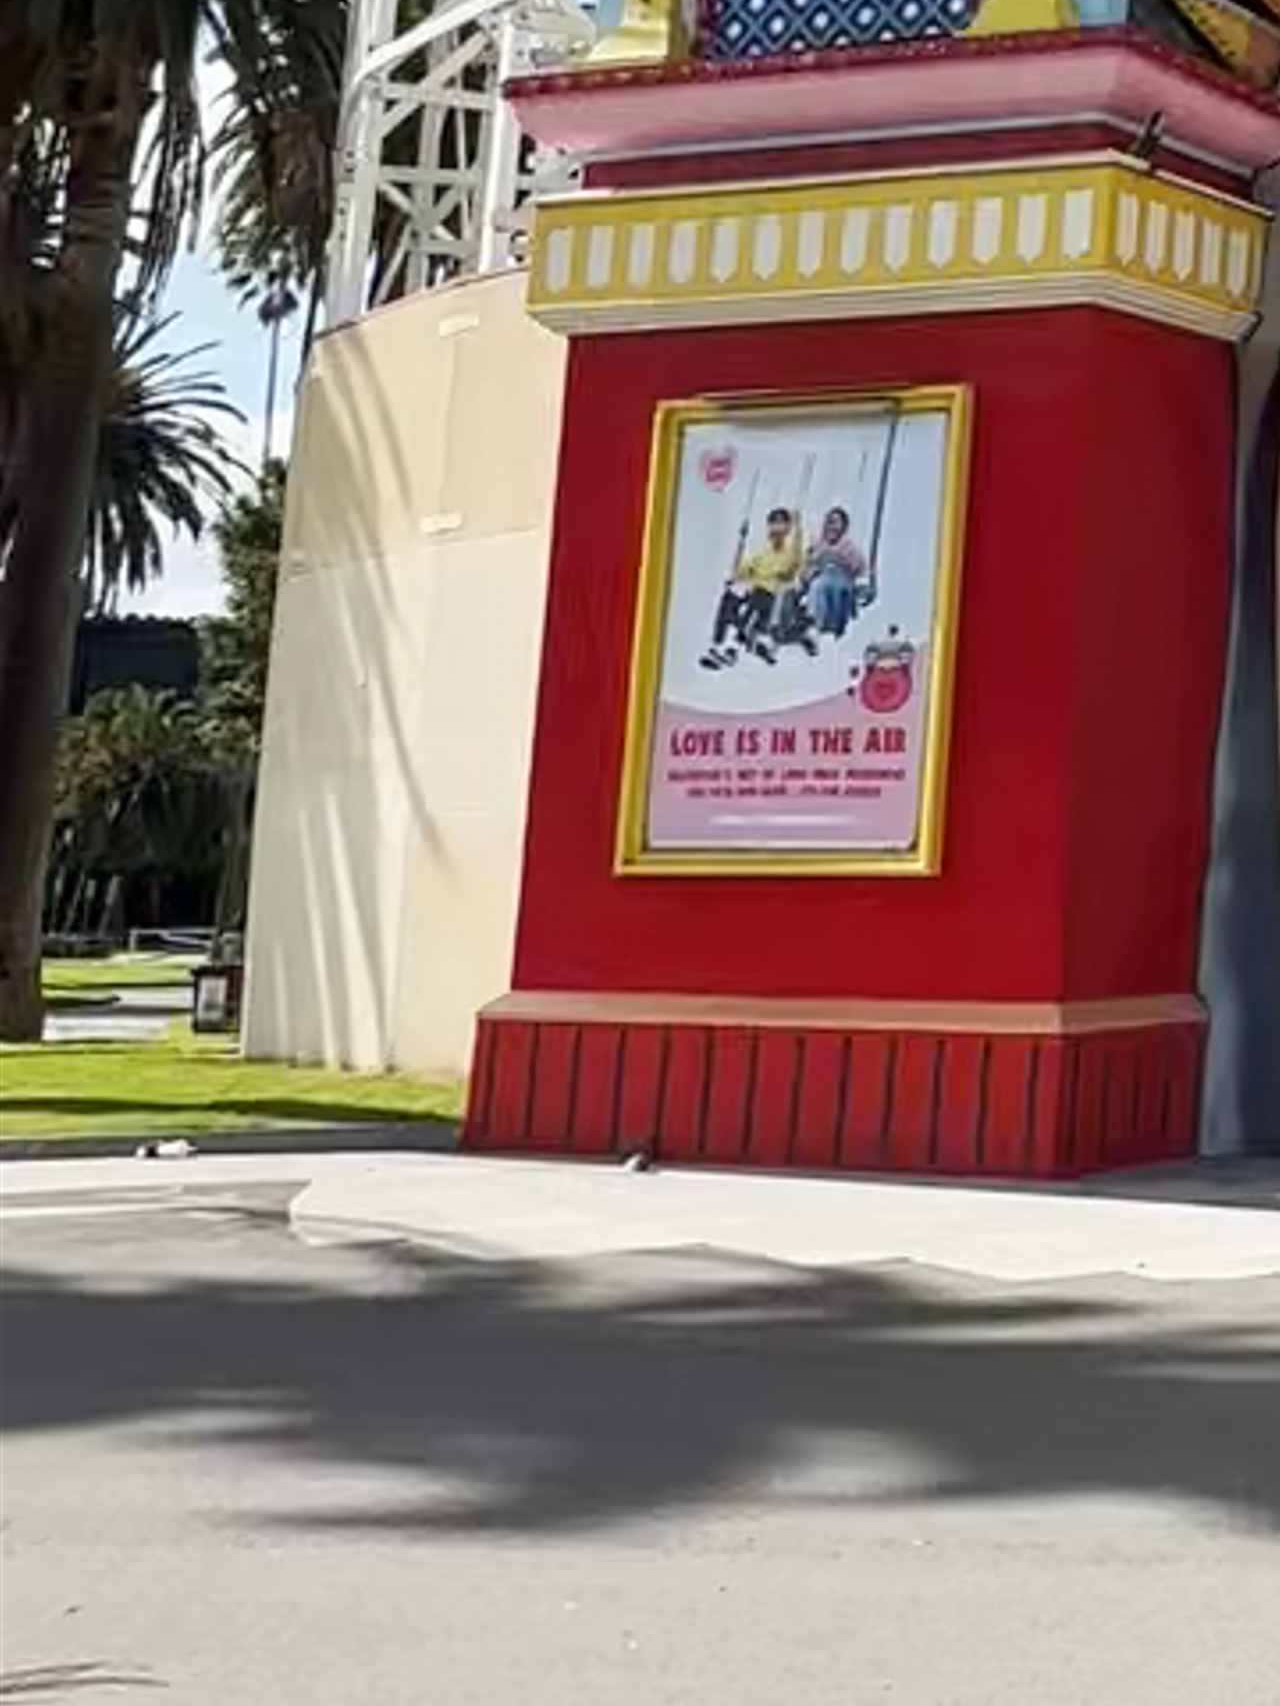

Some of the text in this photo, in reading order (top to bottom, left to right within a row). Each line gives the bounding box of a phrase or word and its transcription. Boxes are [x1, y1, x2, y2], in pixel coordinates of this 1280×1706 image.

[670, 726, 907, 757] LOVE IS IN THE AIR
